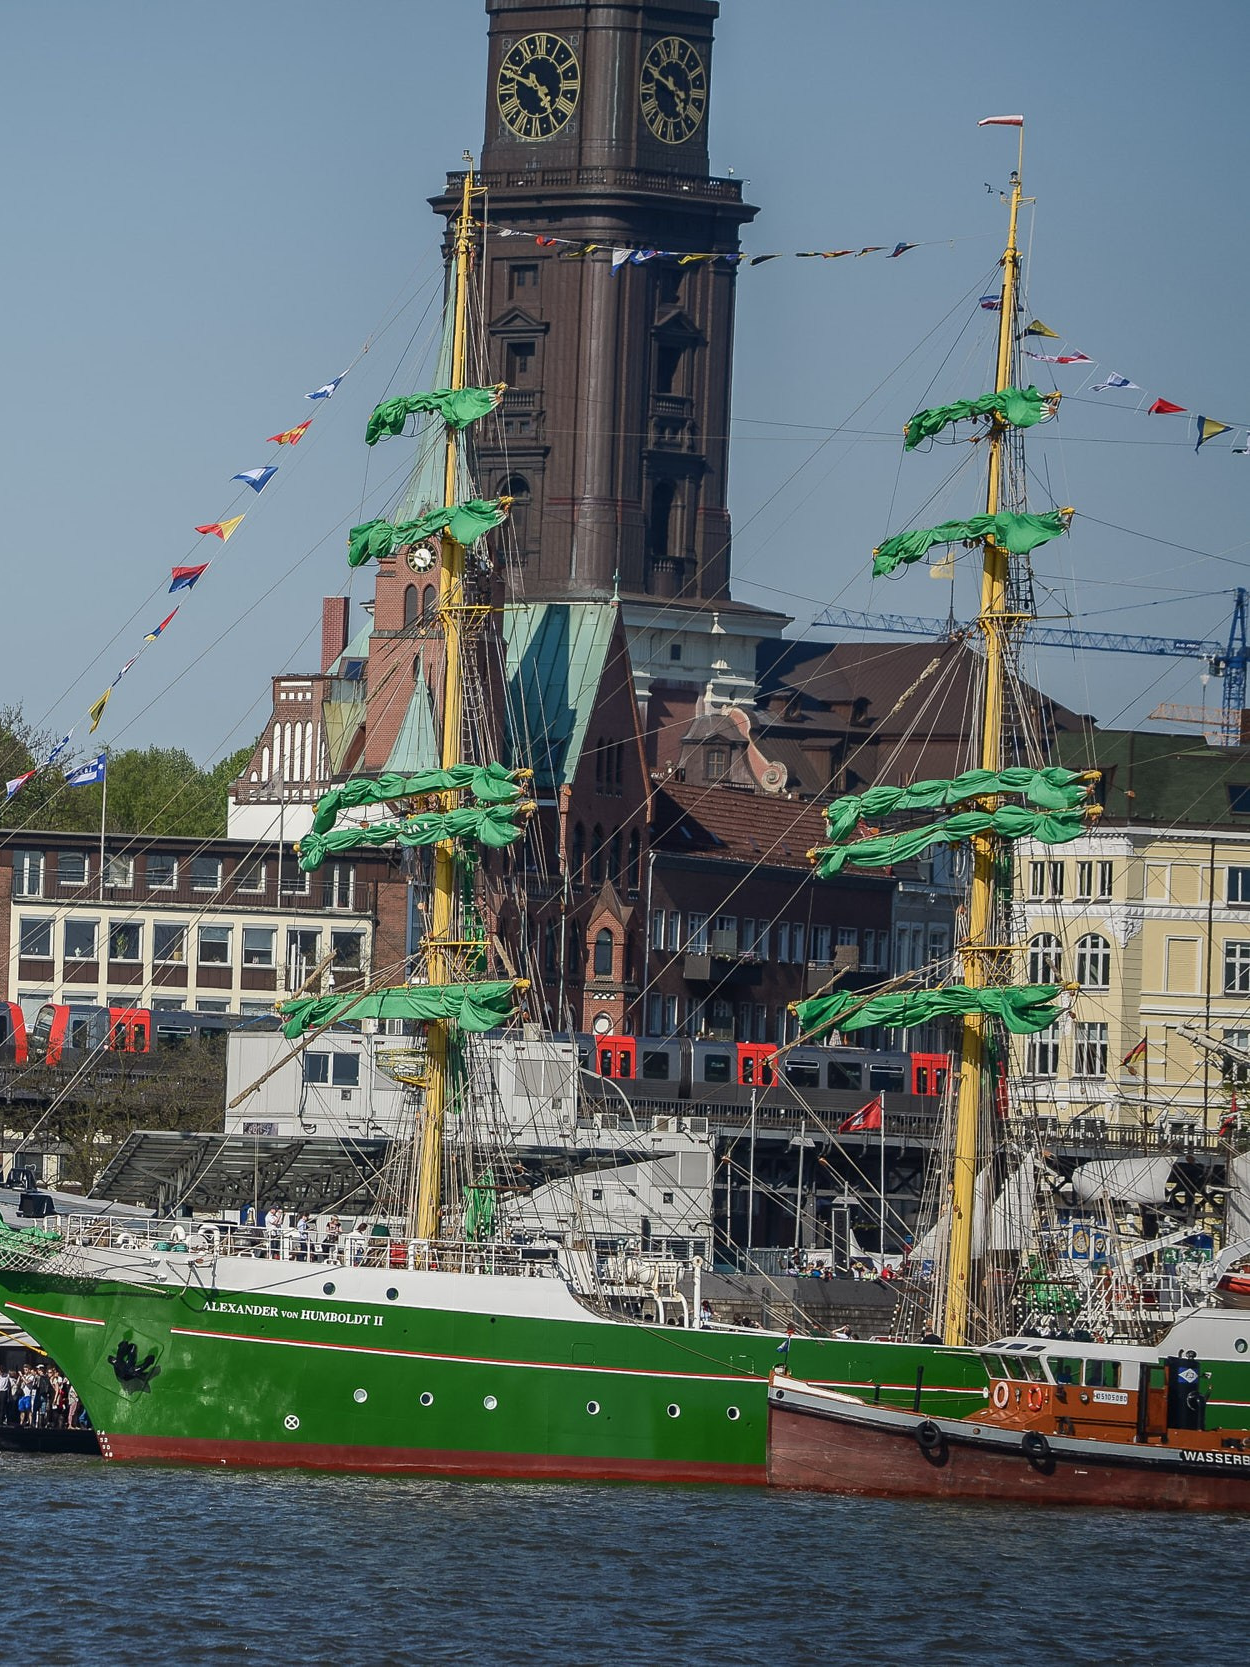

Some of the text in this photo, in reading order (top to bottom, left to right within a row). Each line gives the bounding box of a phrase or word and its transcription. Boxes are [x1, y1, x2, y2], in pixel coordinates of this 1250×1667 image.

[203, 1301, 278, 1317] ALEXANDER
[300, 1309, 371, 1325] HUMBOLDT
[373, 1315, 383, 1326] II
[1183, 1450, 1250, 1466] WASSERB
